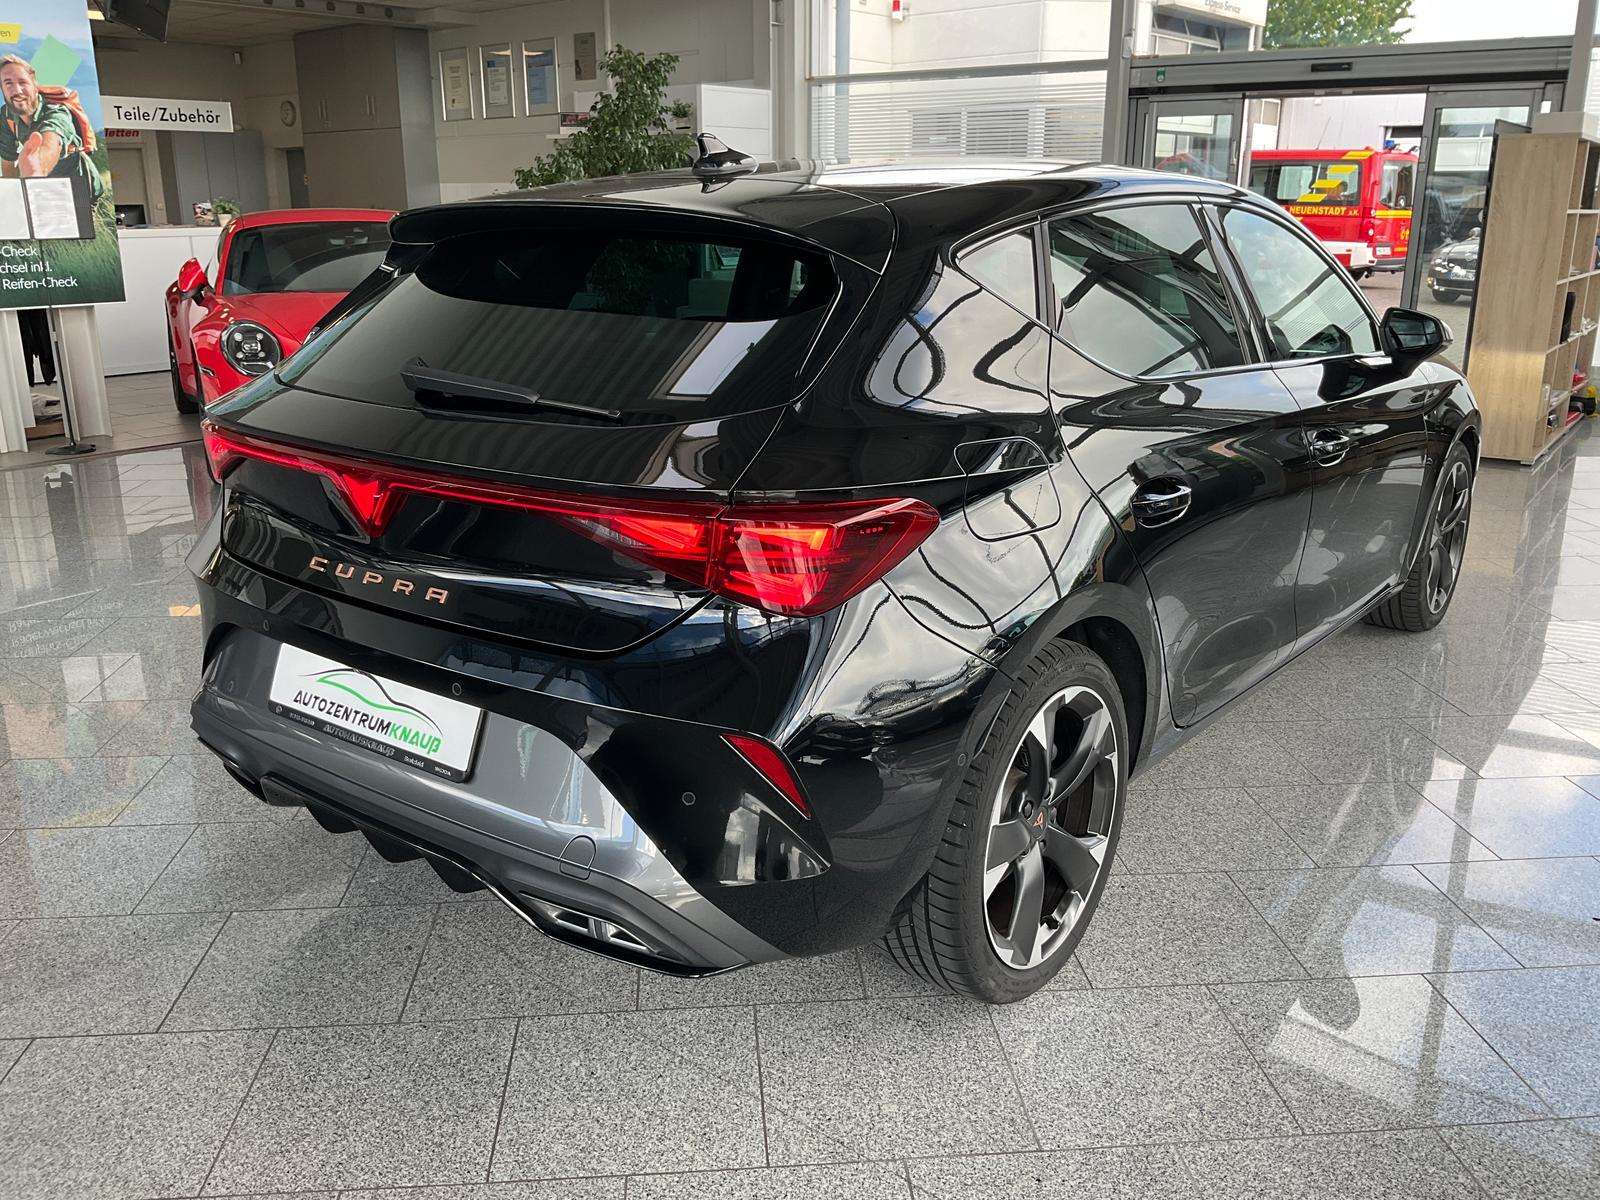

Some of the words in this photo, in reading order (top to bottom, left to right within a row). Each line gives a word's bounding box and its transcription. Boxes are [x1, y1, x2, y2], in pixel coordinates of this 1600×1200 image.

[114, 105, 221, 123] Teile/Zubehör
[1289, 206, 1347, 216] NEUENSTADT
[2, 276, 78, 290] Reifen-Check
[309, 556, 449, 604] CUPRA
